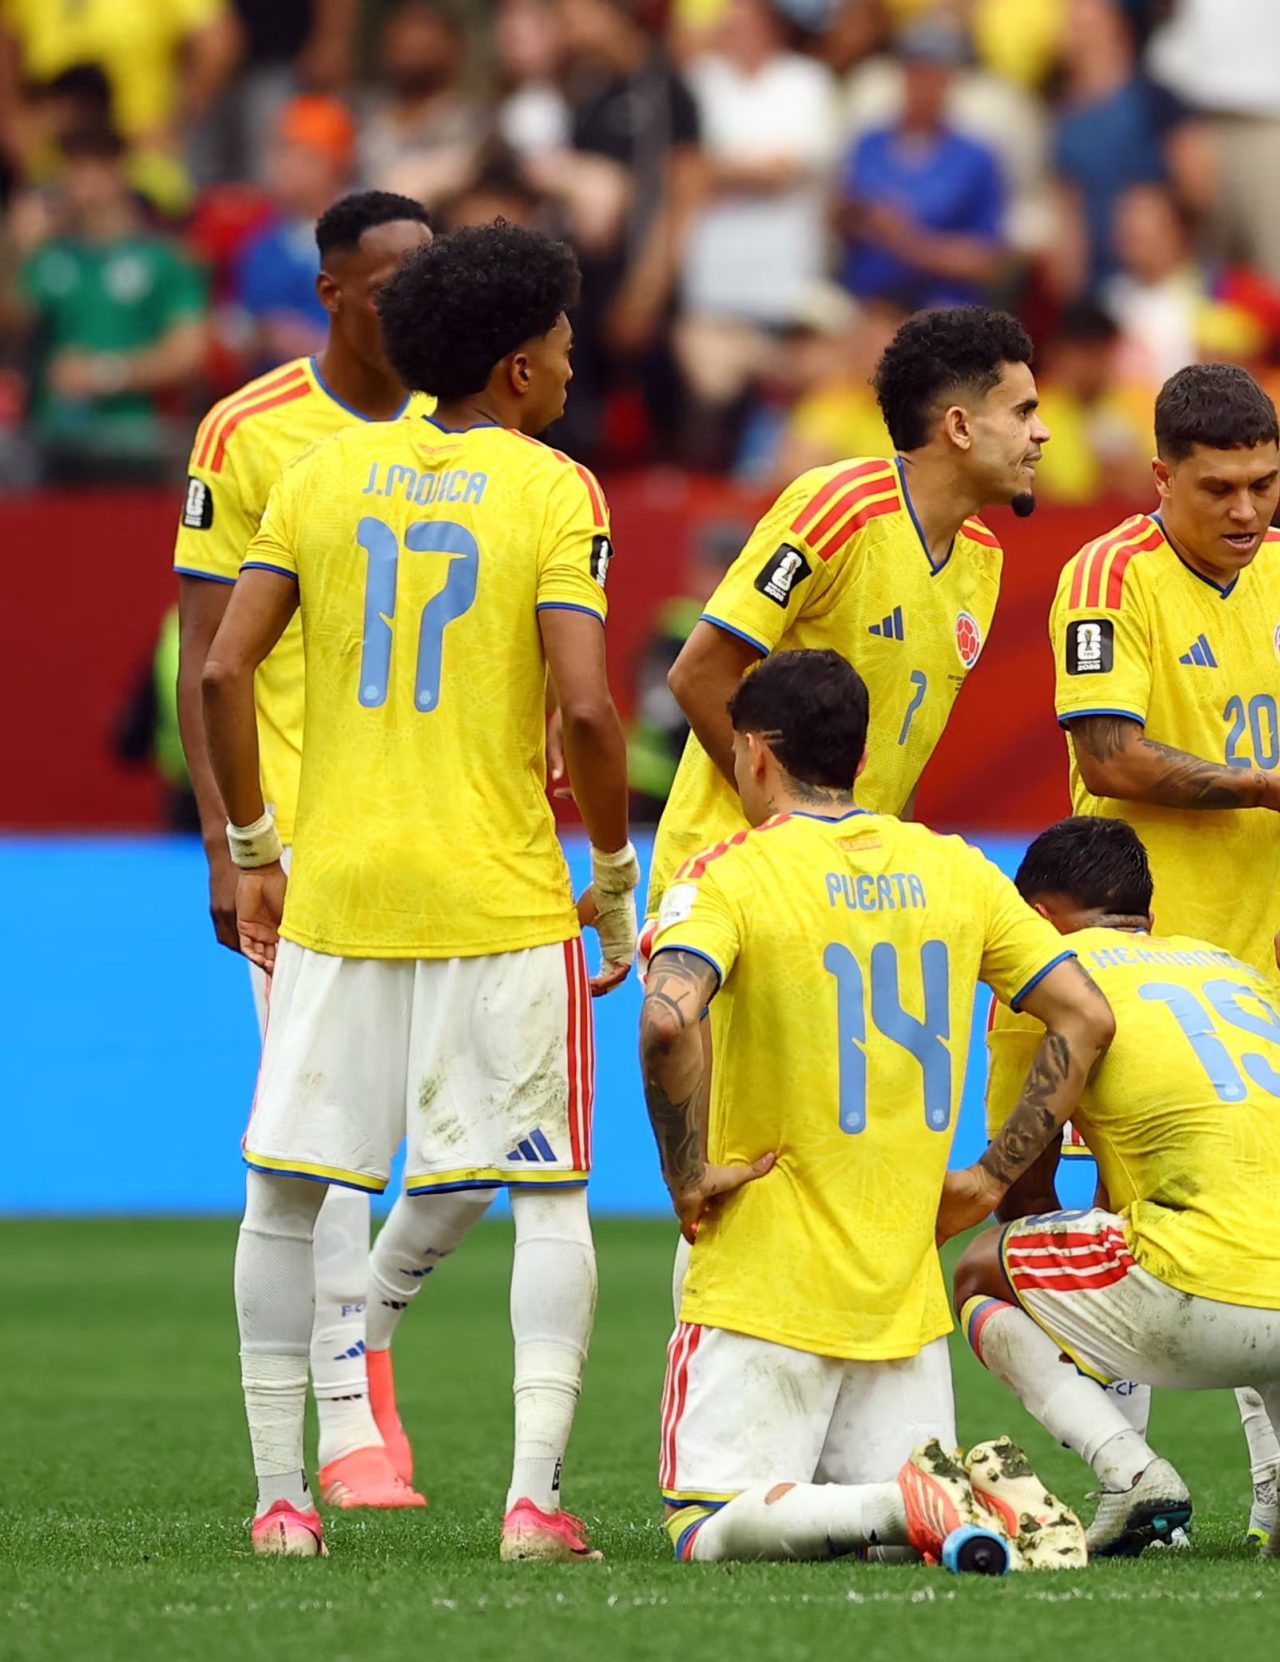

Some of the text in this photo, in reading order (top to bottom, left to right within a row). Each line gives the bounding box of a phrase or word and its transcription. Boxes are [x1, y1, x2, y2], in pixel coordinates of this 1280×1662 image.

[357, 517, 479, 713] 17
[898, 670, 928, 746] 7
[1223, 693, 1280, 770] 20
[825, 872, 927, 911] PUERTA
[823, 940, 951, 1135] 14
